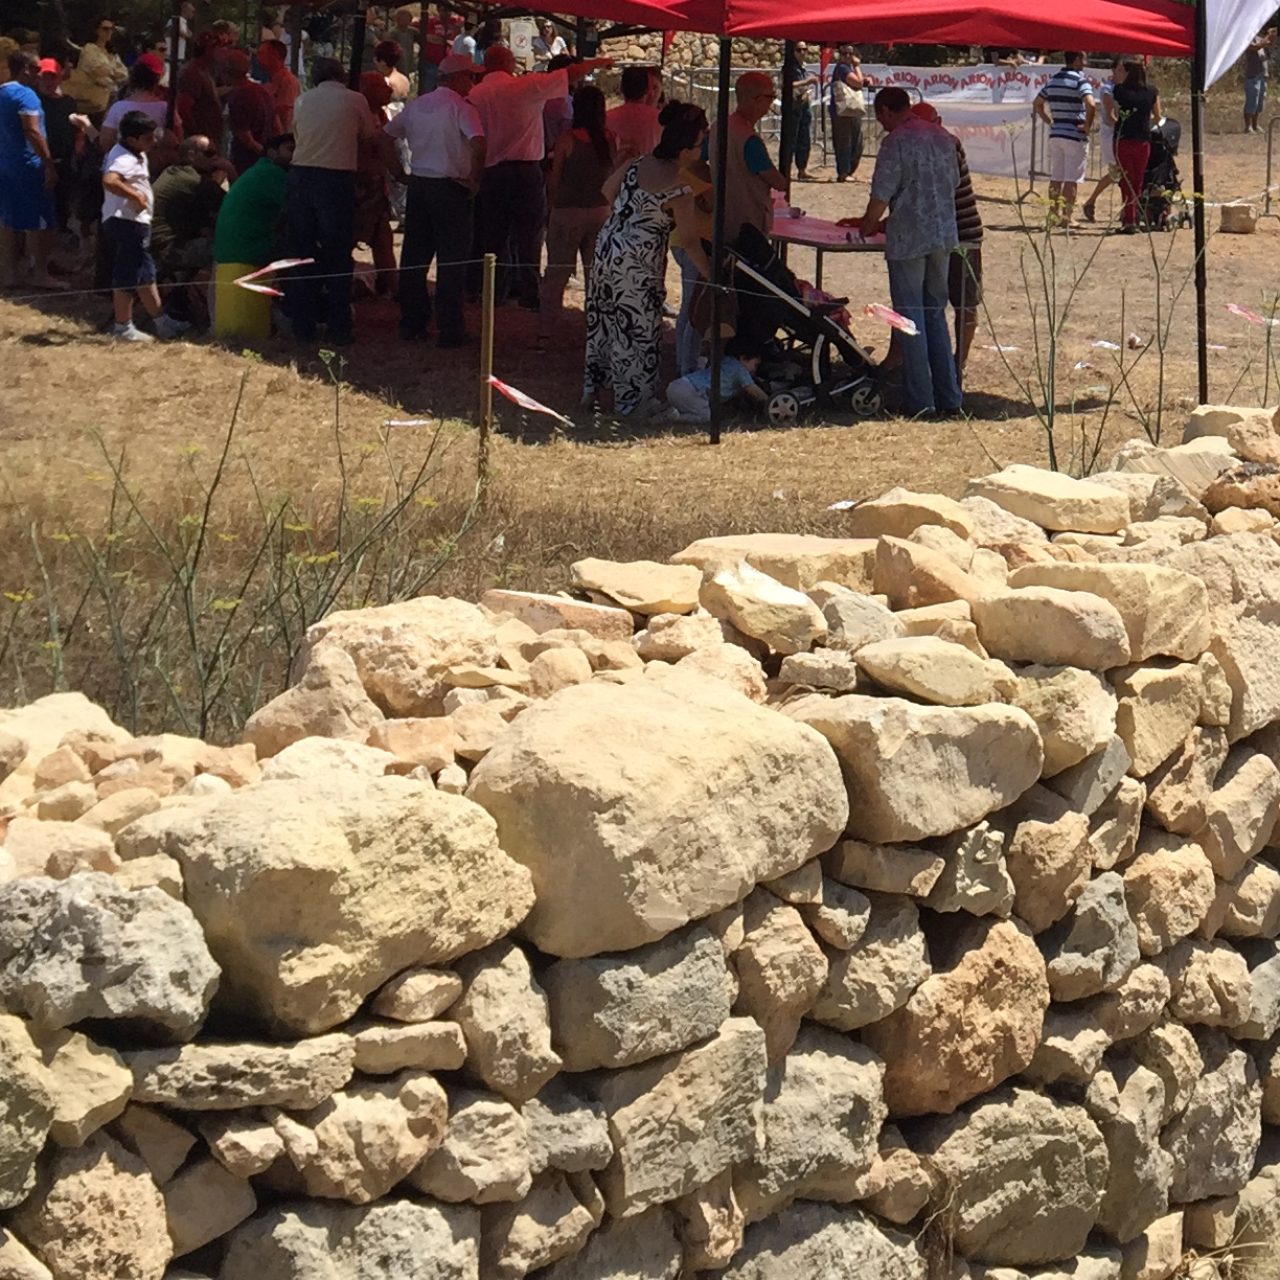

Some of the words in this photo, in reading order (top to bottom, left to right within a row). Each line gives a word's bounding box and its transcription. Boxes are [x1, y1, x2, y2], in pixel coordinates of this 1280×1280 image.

[885, 72, 920, 87] ARION
[923, 73, 959, 89] ARION
[960, 73, 994, 89] ARION
[997, 71, 1031, 86] ARION
